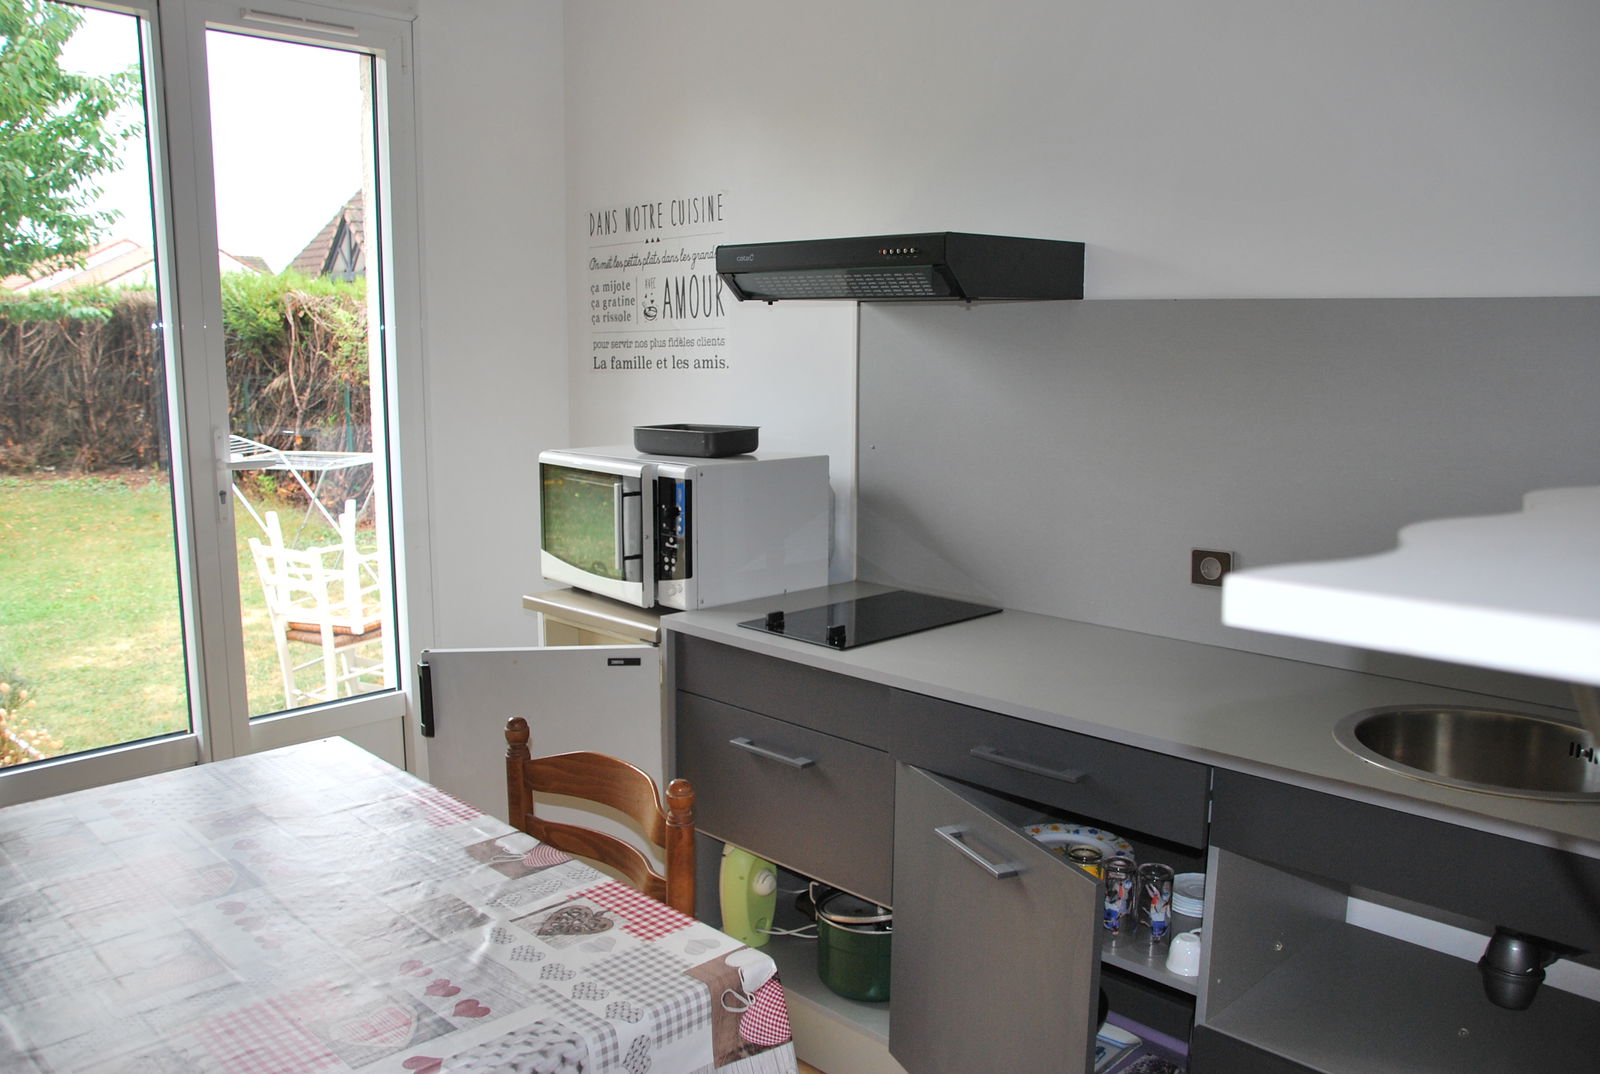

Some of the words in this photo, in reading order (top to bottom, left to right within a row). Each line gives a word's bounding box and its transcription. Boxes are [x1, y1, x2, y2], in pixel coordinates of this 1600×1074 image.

[589, 209, 617, 237] DANS
[625, 202, 663, 233] NOTRE
[671, 193, 723, 226] CUISINE
[641, 250, 661, 271] plats
[662, 250, 679, 264] dans
[680, 248, 691, 262] les
[691, 245, 717, 270] grand
[590, 284, 600, 295] ça
[602, 280, 631, 294] mijote
[591, 301, 600, 310] ça
[602, 297, 636, 310] gratine
[663, 273, 725, 319] AMOUR
[591, 314, 600, 325] ça
[602, 311, 632, 323] rissole
[593, 340, 609, 351] pour
[611, 339, 632, 349] servir
[635, 340, 648, 349] nos
[650, 338, 666, 350] plus
[668, 337, 695, 348] fidèles
[697, 336, 726, 347] clients
[593, 356, 607, 370] La
[610, 355, 653, 370] famille
[656, 357, 668, 369] et
[672, 355, 690, 369] les
[693, 355, 730, 369] amis.
